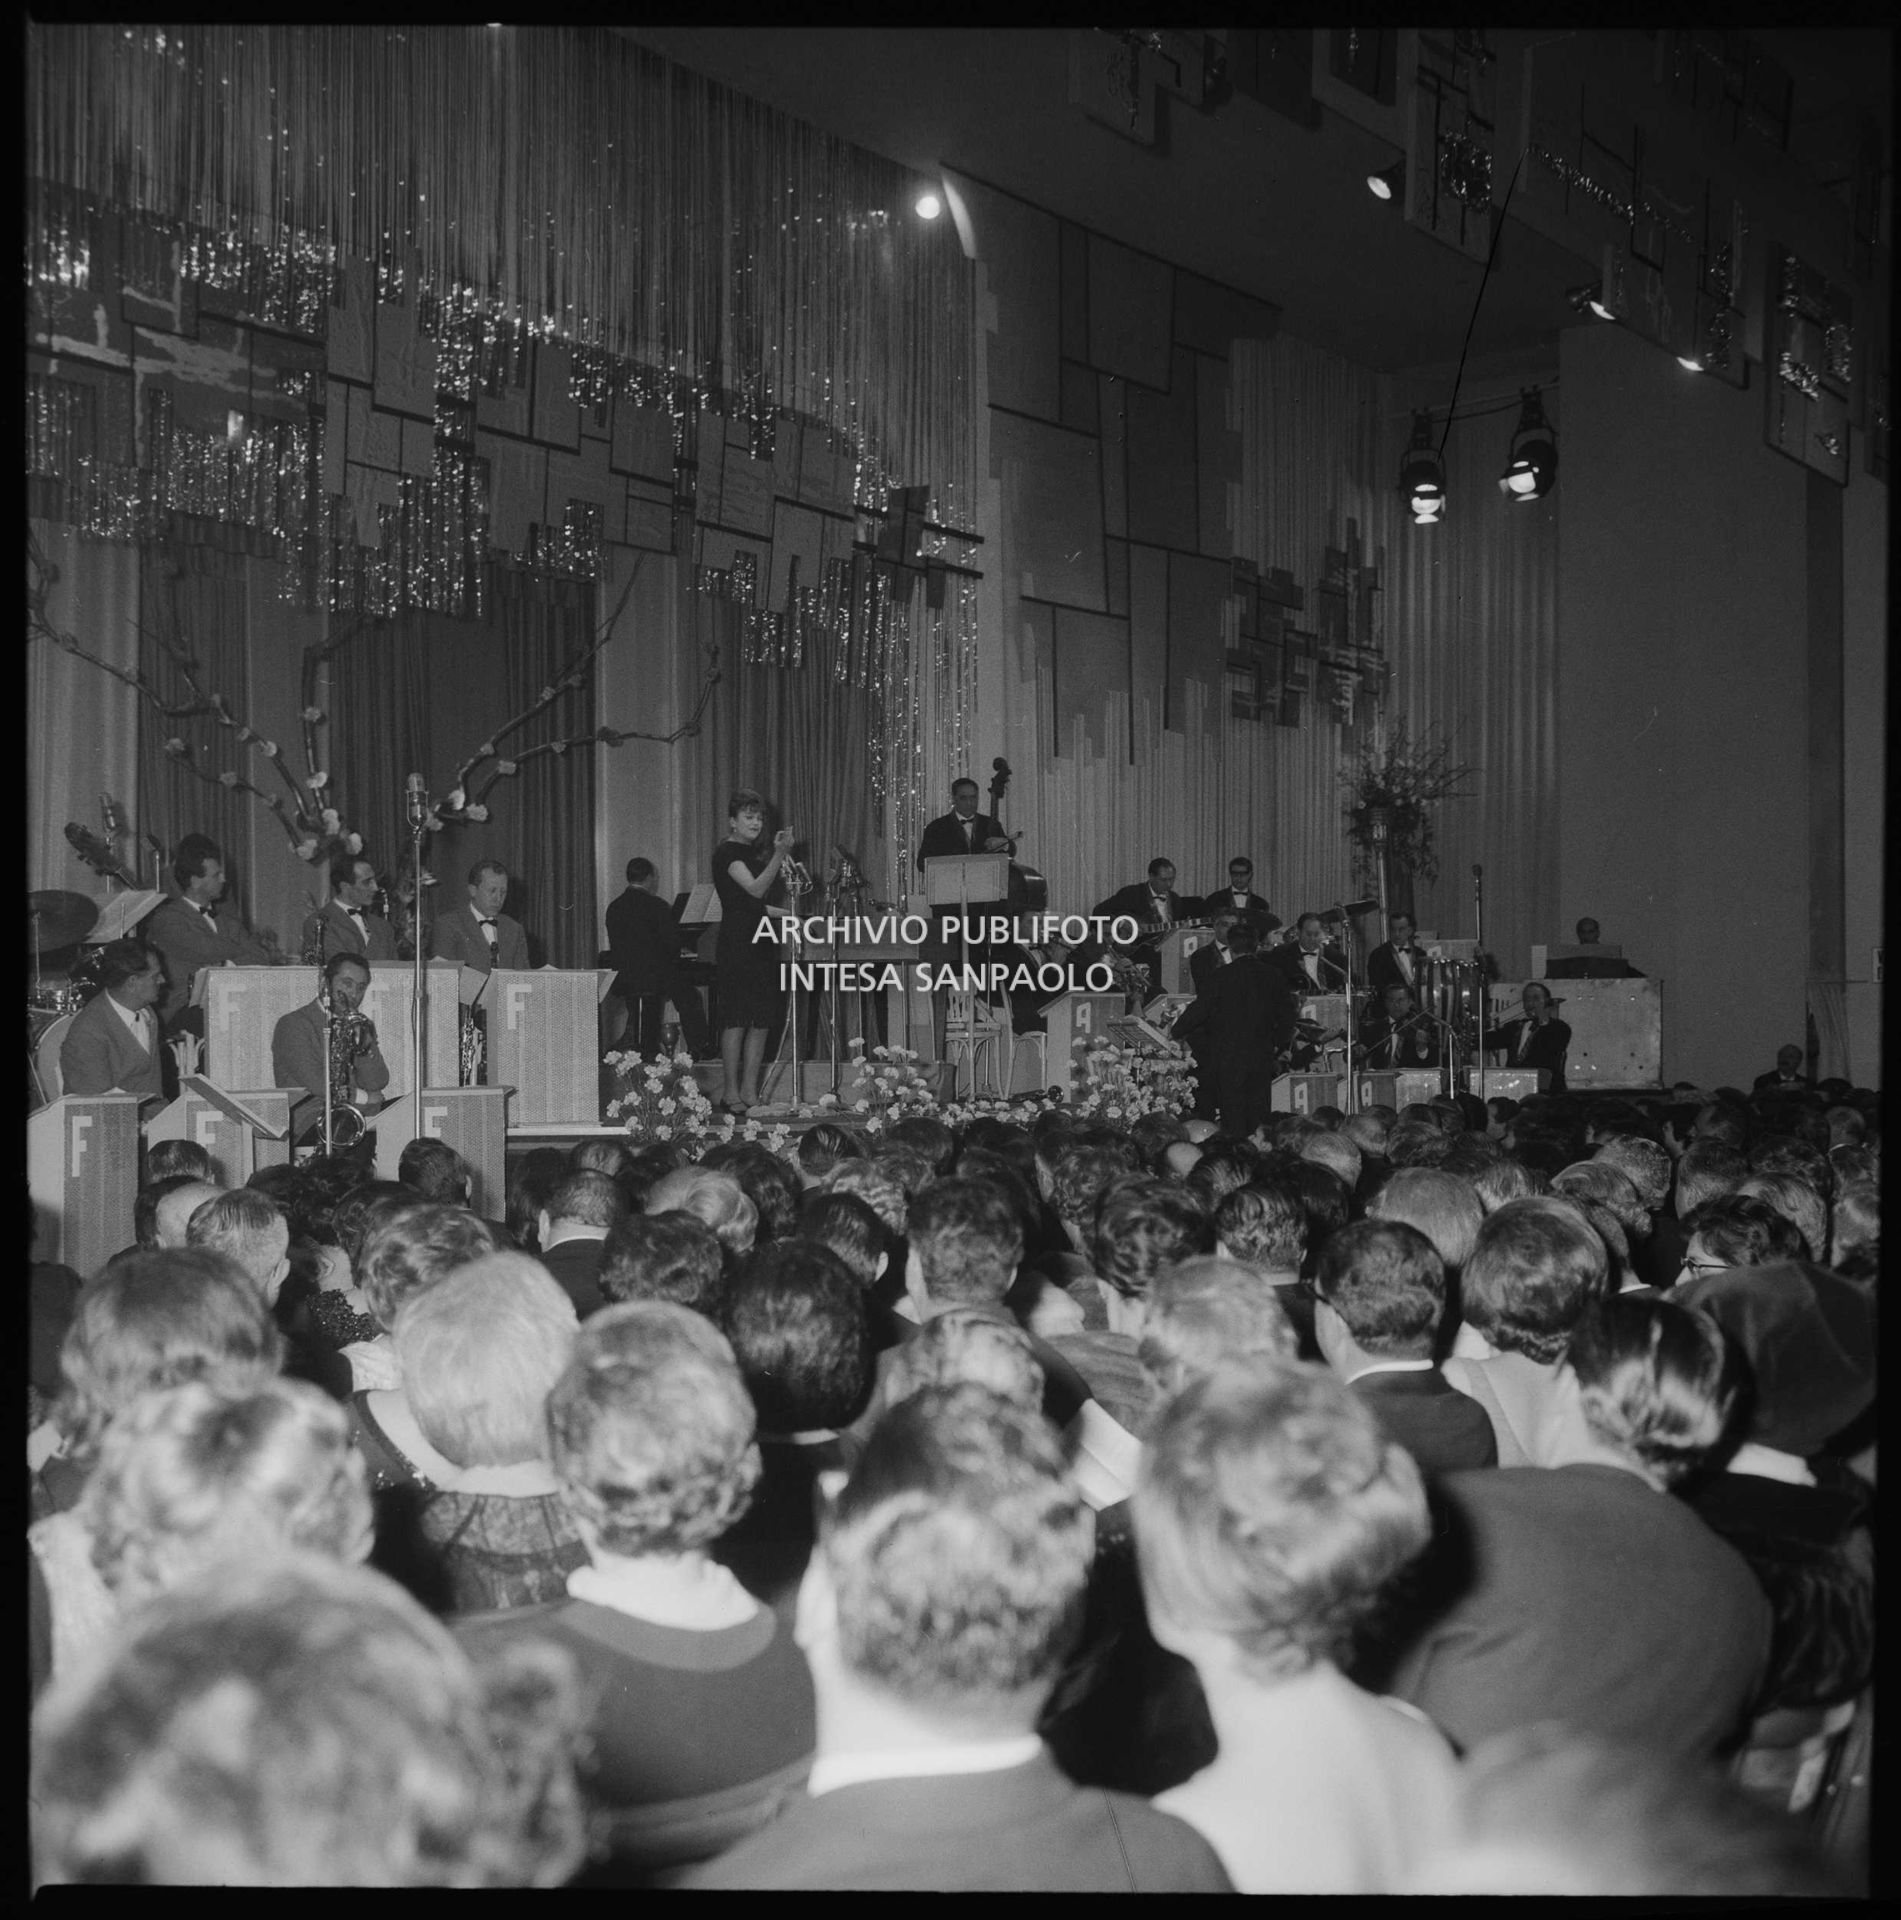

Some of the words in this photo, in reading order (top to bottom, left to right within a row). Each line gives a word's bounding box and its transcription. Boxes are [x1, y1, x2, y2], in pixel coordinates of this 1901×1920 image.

[218, 983, 247, 1031] F
[506, 984, 532, 1030] F
[1076, 1002, 1091, 1034] A
[1294, 1082, 1308, 1115] A
[72, 1116, 93, 1178] F
